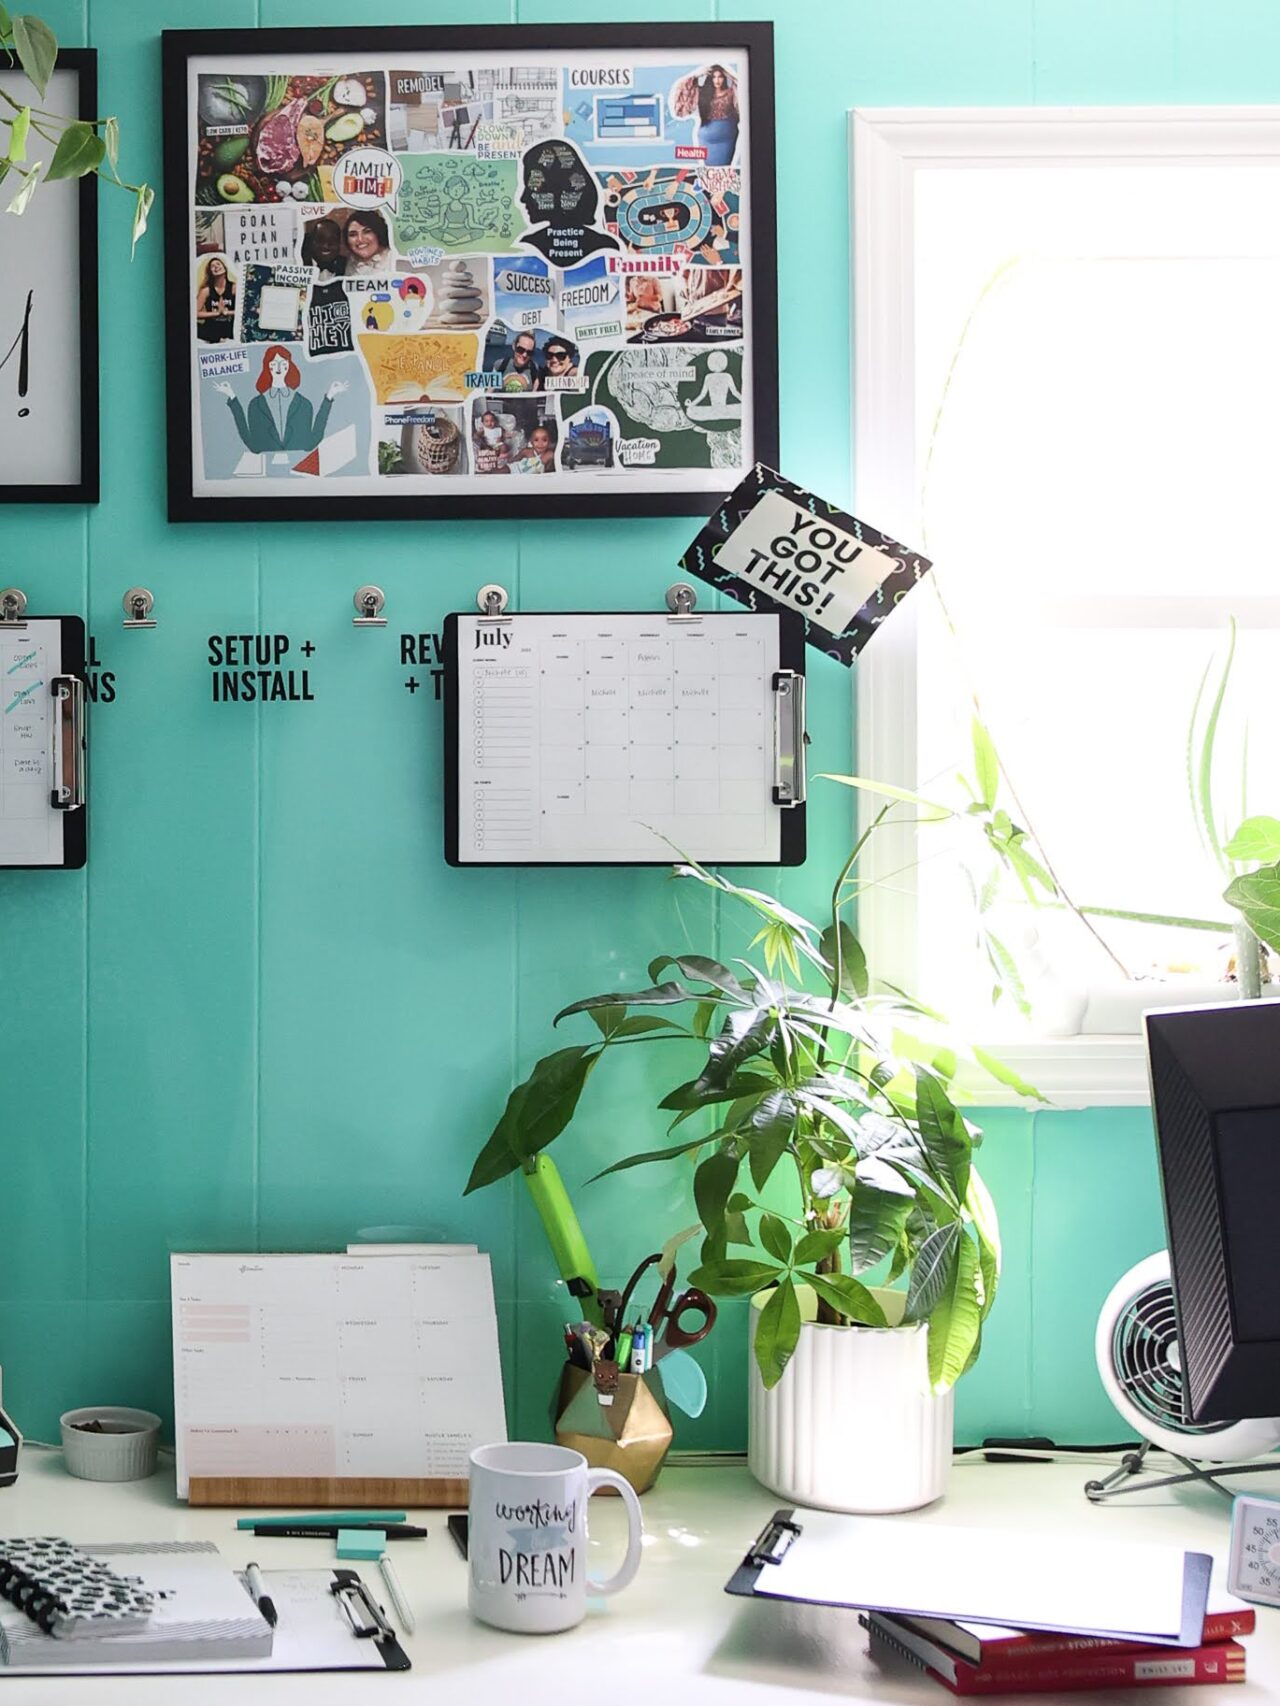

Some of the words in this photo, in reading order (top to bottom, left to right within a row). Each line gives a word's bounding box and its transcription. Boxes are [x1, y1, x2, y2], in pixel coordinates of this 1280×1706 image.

[397, 75, 444, 94] REMODEL
[572, 69, 631, 86] COURSES
[478, 143, 490, 151] BE
[676, 149, 705, 159] Health
[478, 151, 522, 159] PRESENT
[344, 160, 394, 176] FAMILY
[345, 177, 393, 198] TIME!
[240, 214, 276, 228] GOAL
[241, 231, 277, 245] PLAN
[547, 228, 584, 237] Practice
[553, 238, 579, 249] Being
[234, 246, 288, 263] ACTION
[549, 249, 584, 257] Present
[276, 265, 314, 276] PASSIVE
[609, 256, 681, 276] Family
[276, 275, 313, 285] INCOME
[346, 280, 389, 291] TEAM
[506, 273, 551, 295] SUCCESS
[561, 283, 609, 307] FREEDOM
[521, 310, 542, 326] DEBT
[310, 322, 350, 350] HEY
[578, 327, 598, 338] DEBT
[599, 324, 618, 334] FREE
[200, 350, 248, 365] WORK-LIFE
[202, 363, 244, 378] BALANCE
[625, 370, 655, 380] peace
[656, 369, 666, 378] of
[669, 369, 695, 378] mind
[465, 374, 502, 388] TRAVEL
[546, 376, 589, 388] FRIENDSHIP
[615, 440, 658, 452] Vacation
[789, 512, 863, 564] YOU
[770, 536, 845, 585] GOT
[744, 548, 835, 616] THIS!
[474, 627, 514, 650] July
[208, 635, 290, 666] SETUP
[212, 670, 314, 702] INSTALL
[495, 1498, 576, 1533] working
[1266, 1517, 1278, 1527] 55
[1253, 1526, 1264, 1536] 50
[1245, 1544, 1257, 1553] 45
[499, 1548, 575, 1587] DREAM
[1248, 1561, 1259, 1570] 40
[1259, 1577, 1271, 1586] 35
